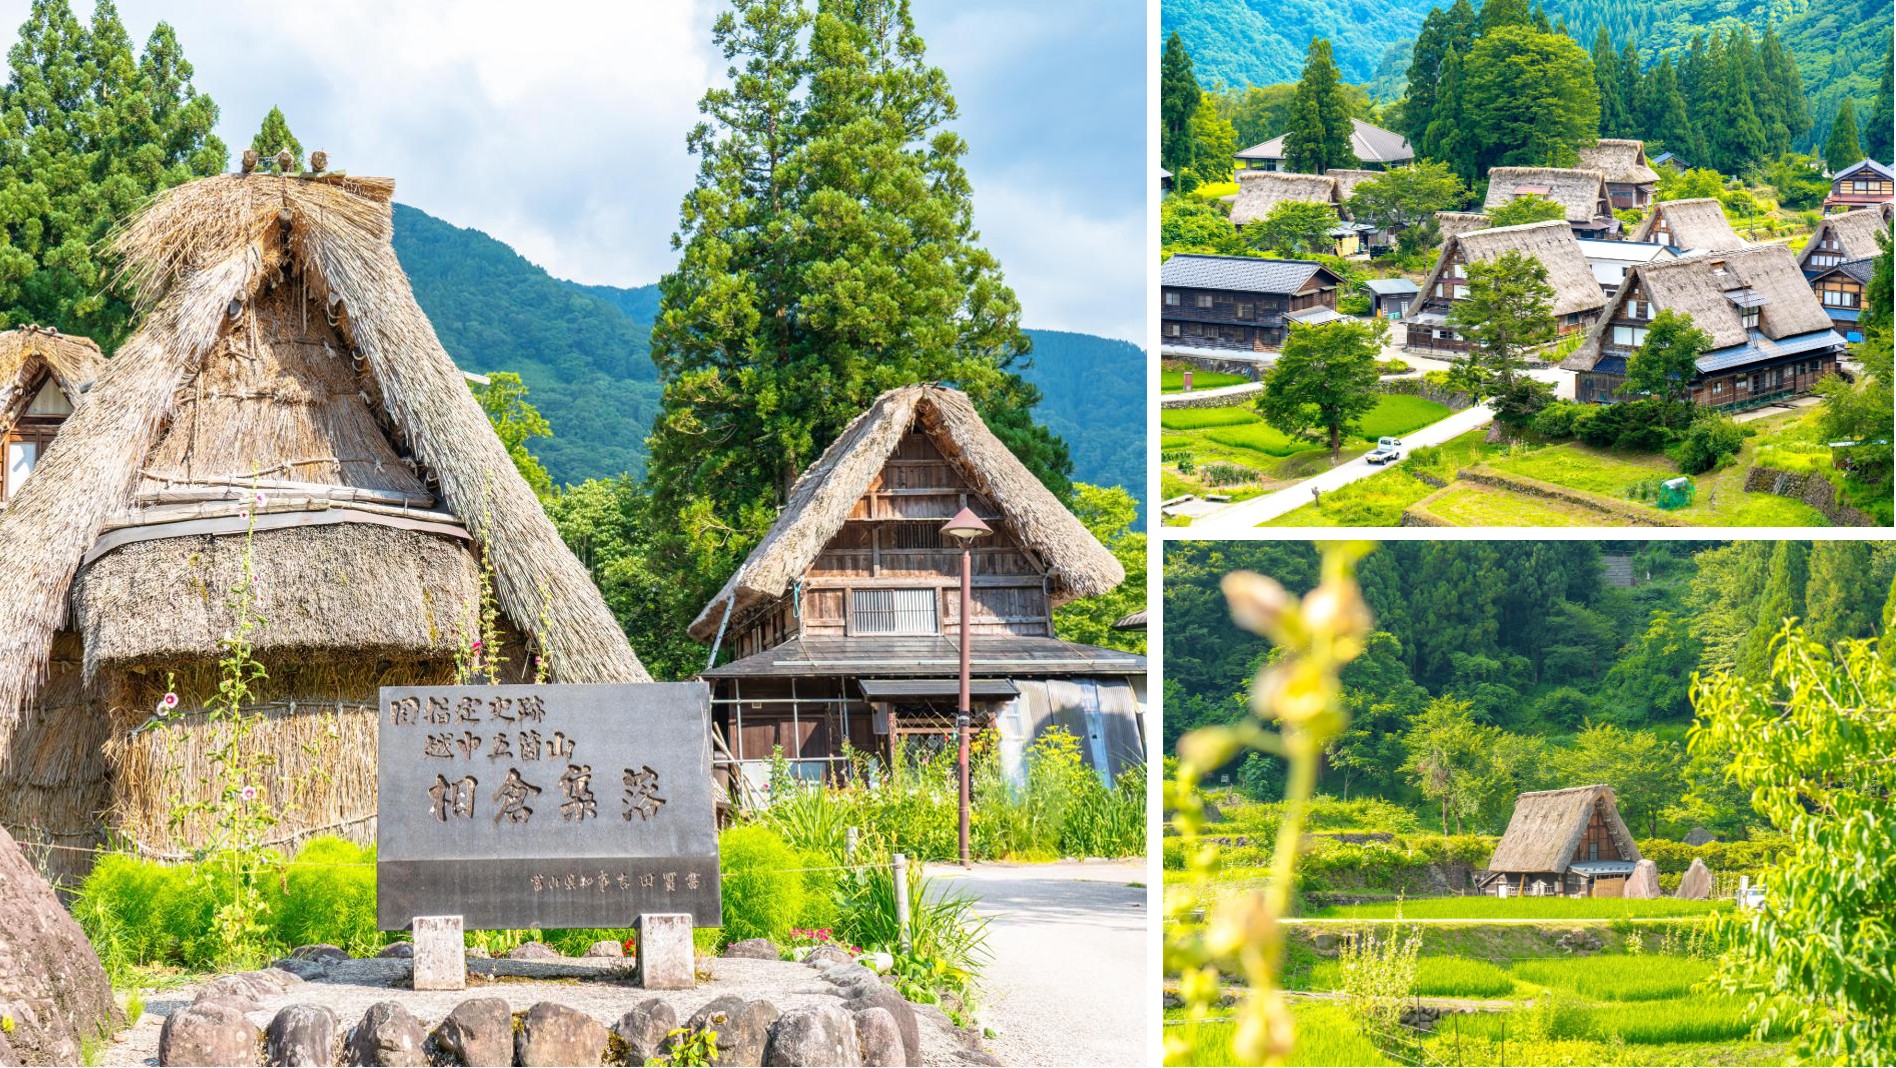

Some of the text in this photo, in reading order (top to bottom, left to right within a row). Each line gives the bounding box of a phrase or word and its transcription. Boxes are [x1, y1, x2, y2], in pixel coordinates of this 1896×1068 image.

[425, 729, 576, 761] 越中五箇山
[428, 764, 667, 826] 相倉集落
